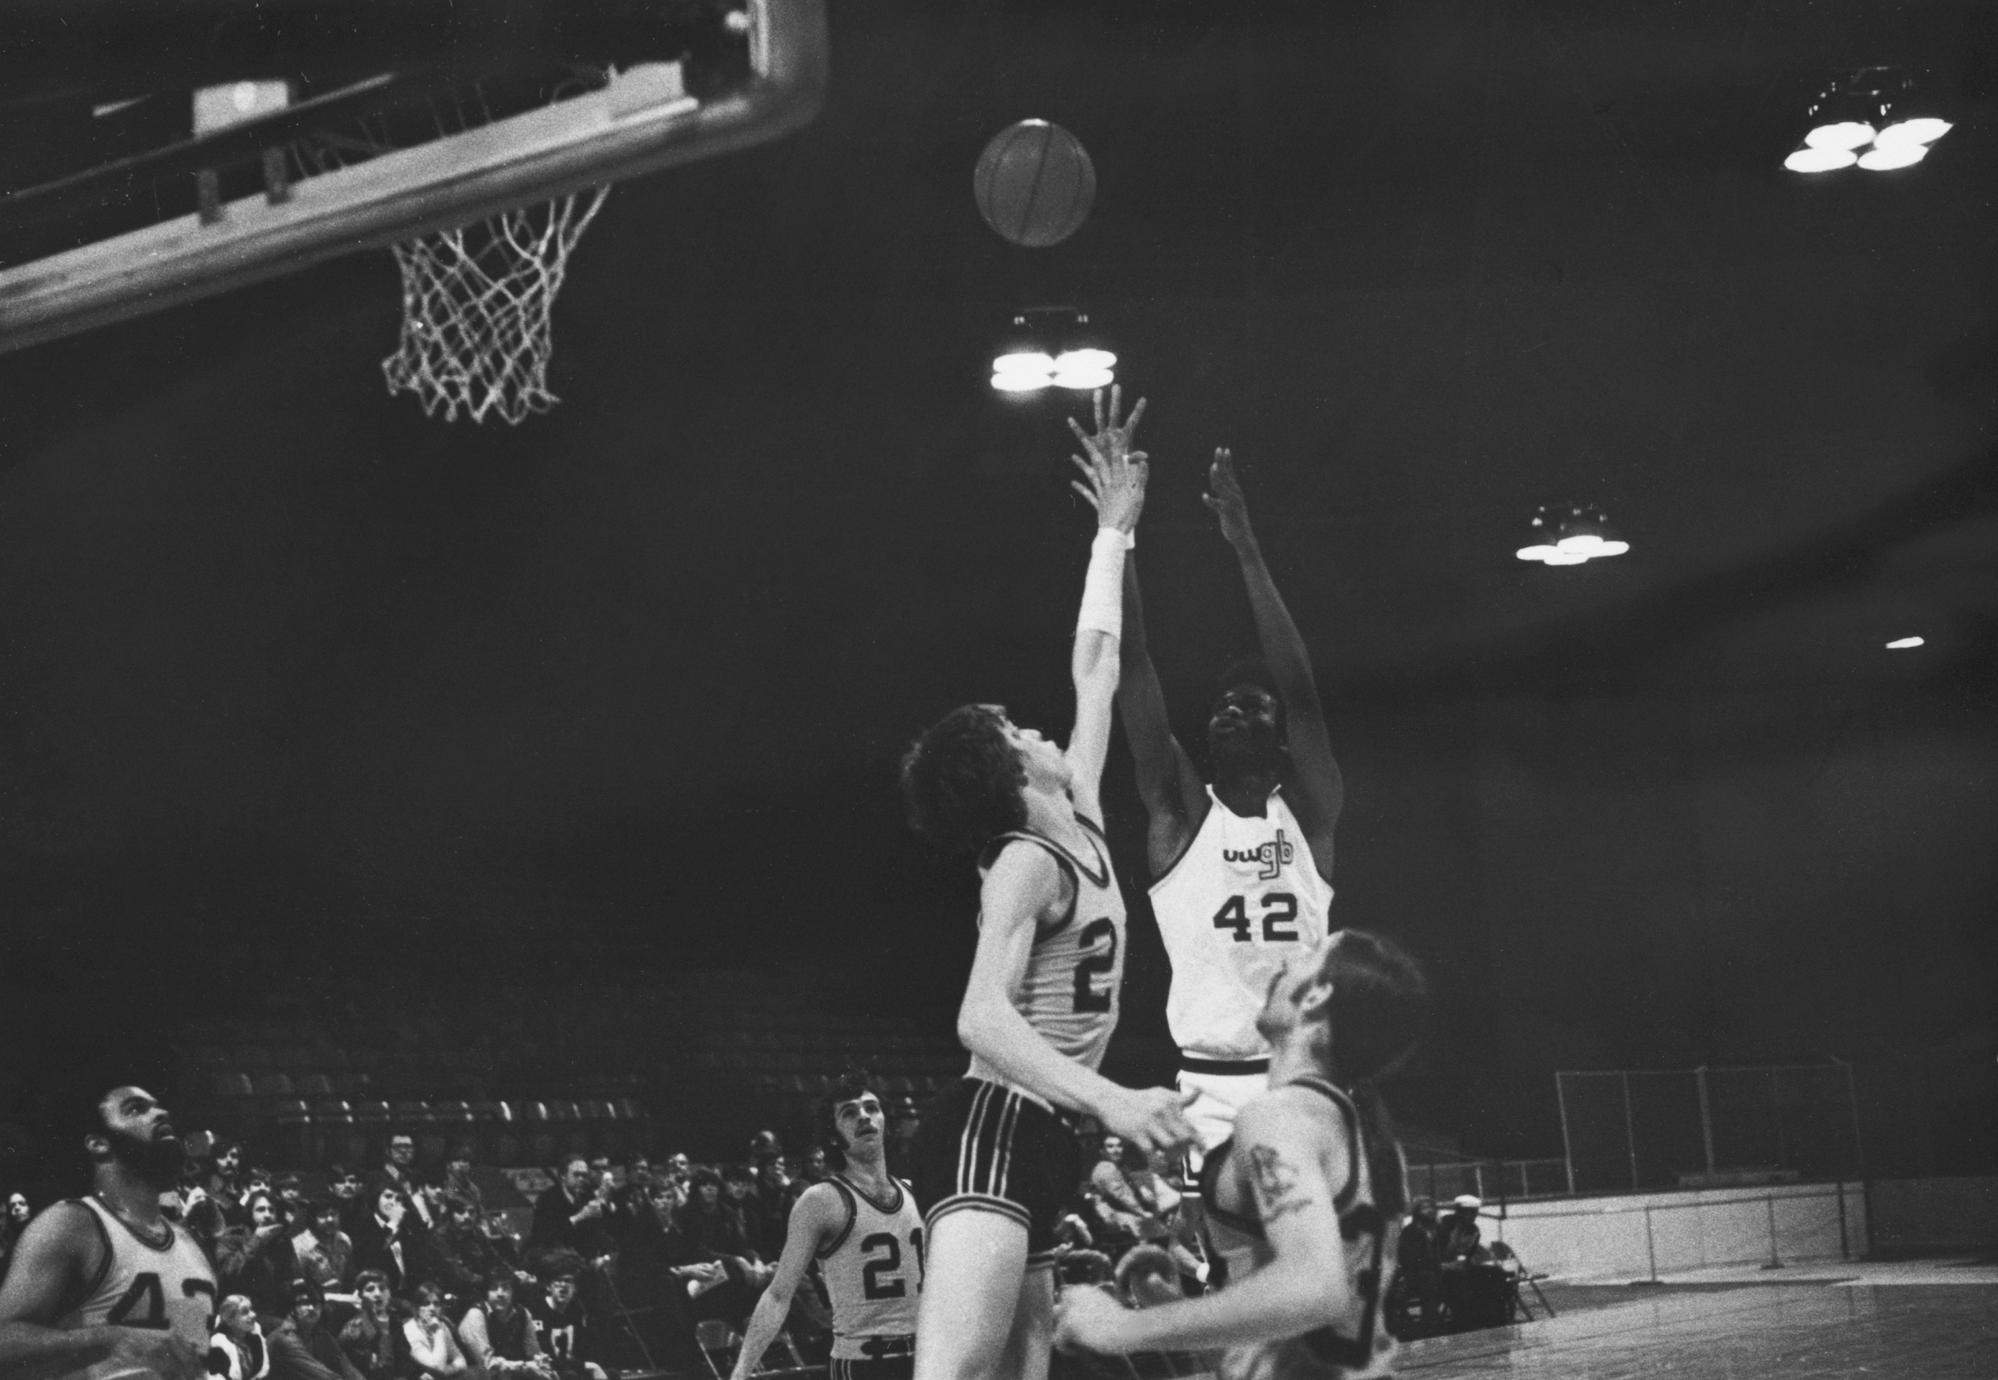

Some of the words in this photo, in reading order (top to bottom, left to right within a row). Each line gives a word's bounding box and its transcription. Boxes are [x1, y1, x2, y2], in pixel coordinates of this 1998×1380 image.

[1222, 829, 1294, 880] uwgb
[1213, 893, 1299, 942] 42
[860, 1228, 925, 1300] 21
